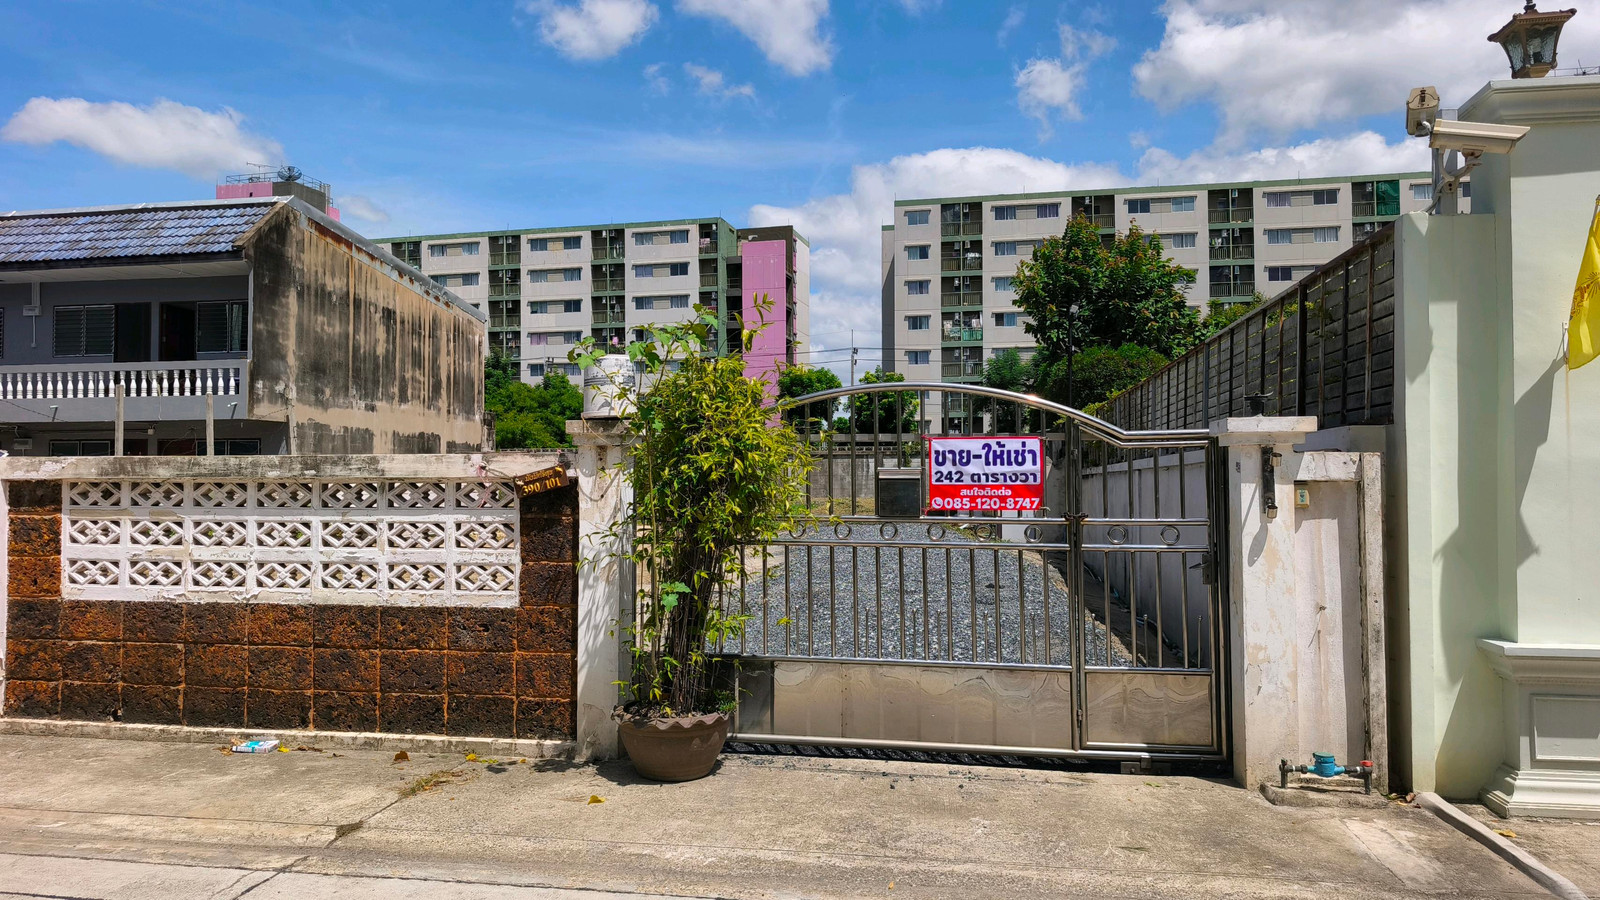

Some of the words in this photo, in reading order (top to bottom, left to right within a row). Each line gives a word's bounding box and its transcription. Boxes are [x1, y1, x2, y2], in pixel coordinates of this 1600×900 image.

[934, 441, 1037, 467] ขาย-ให้เช่า
[934, 471, 964, 483] 242
[970, 472, 1038, 483] ตารางวา
[960, 487, 1012, 496] สนใจติดต่อ
[944, 498, 1040, 509] 085-120-8747
